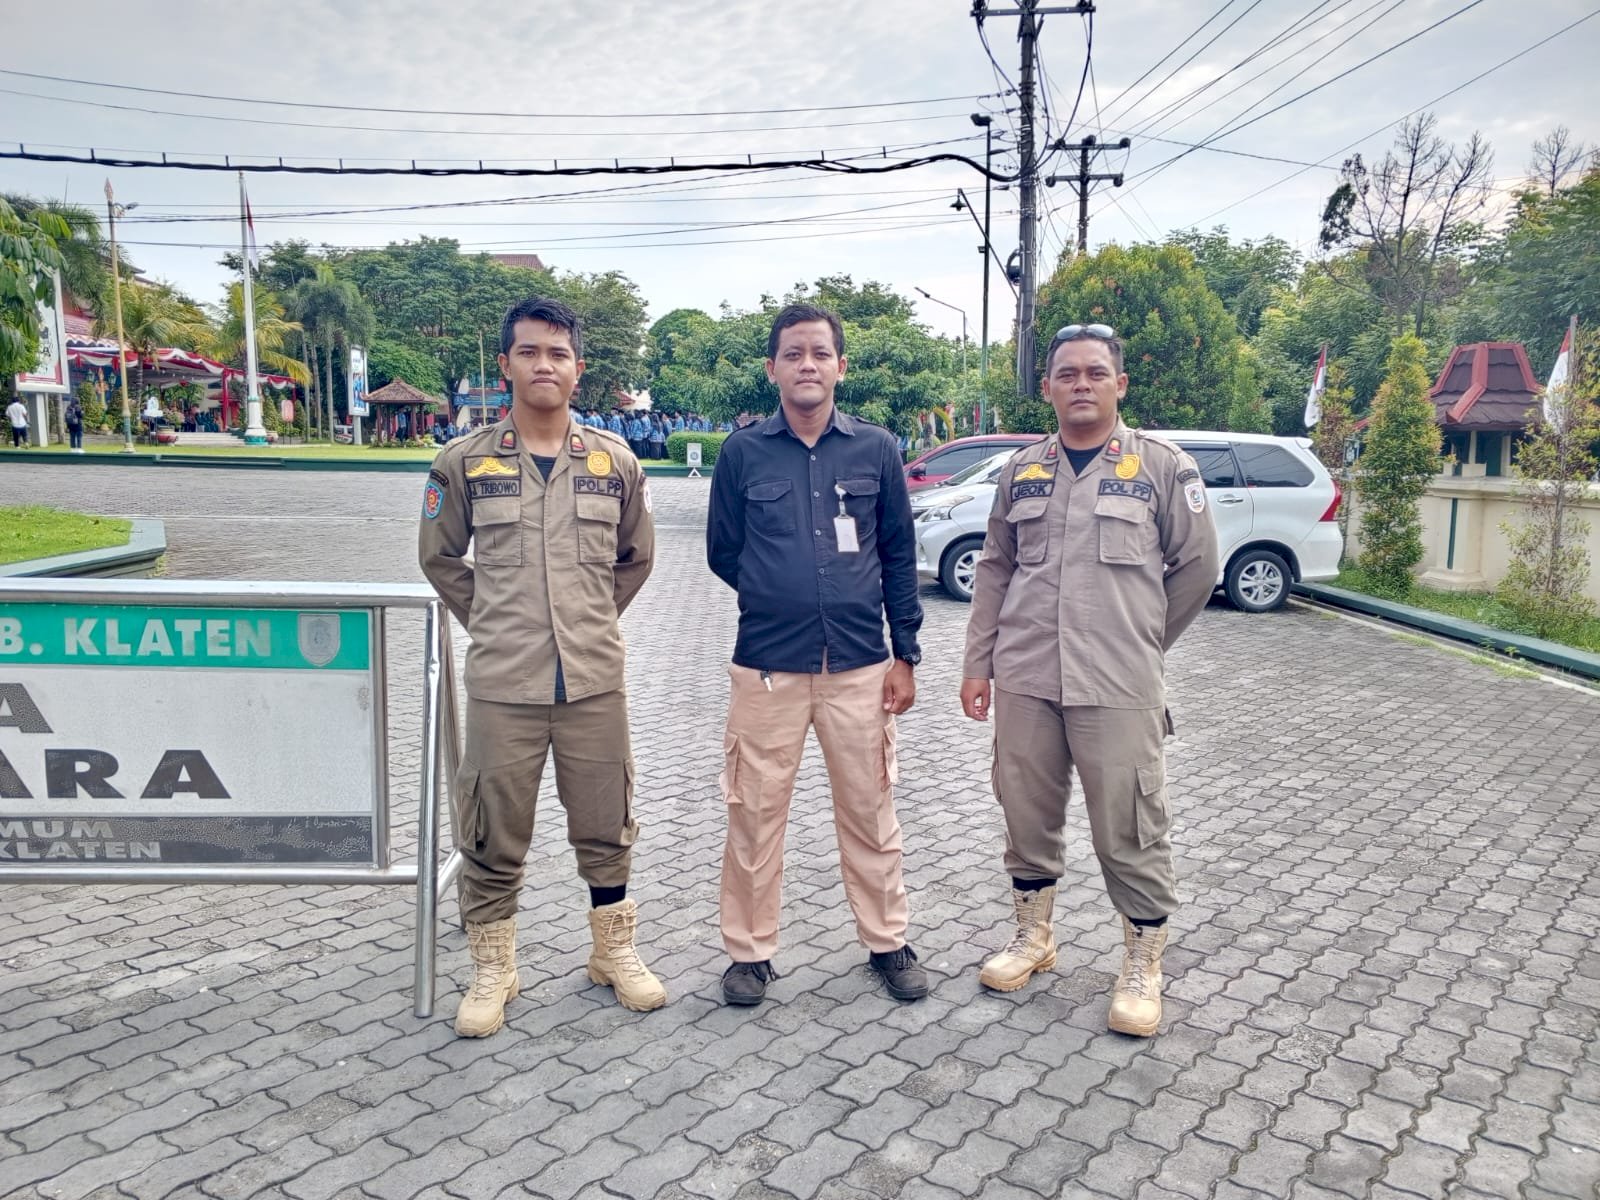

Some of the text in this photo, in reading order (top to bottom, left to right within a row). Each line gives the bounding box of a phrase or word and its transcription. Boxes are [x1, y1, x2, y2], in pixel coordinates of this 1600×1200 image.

[577, 479, 621, 495] POL PP
[1014, 483, 1048, 498] JEOK
[1103, 482, 1149, 496] POL PP
[64, 618, 271, 656] KLATEN
